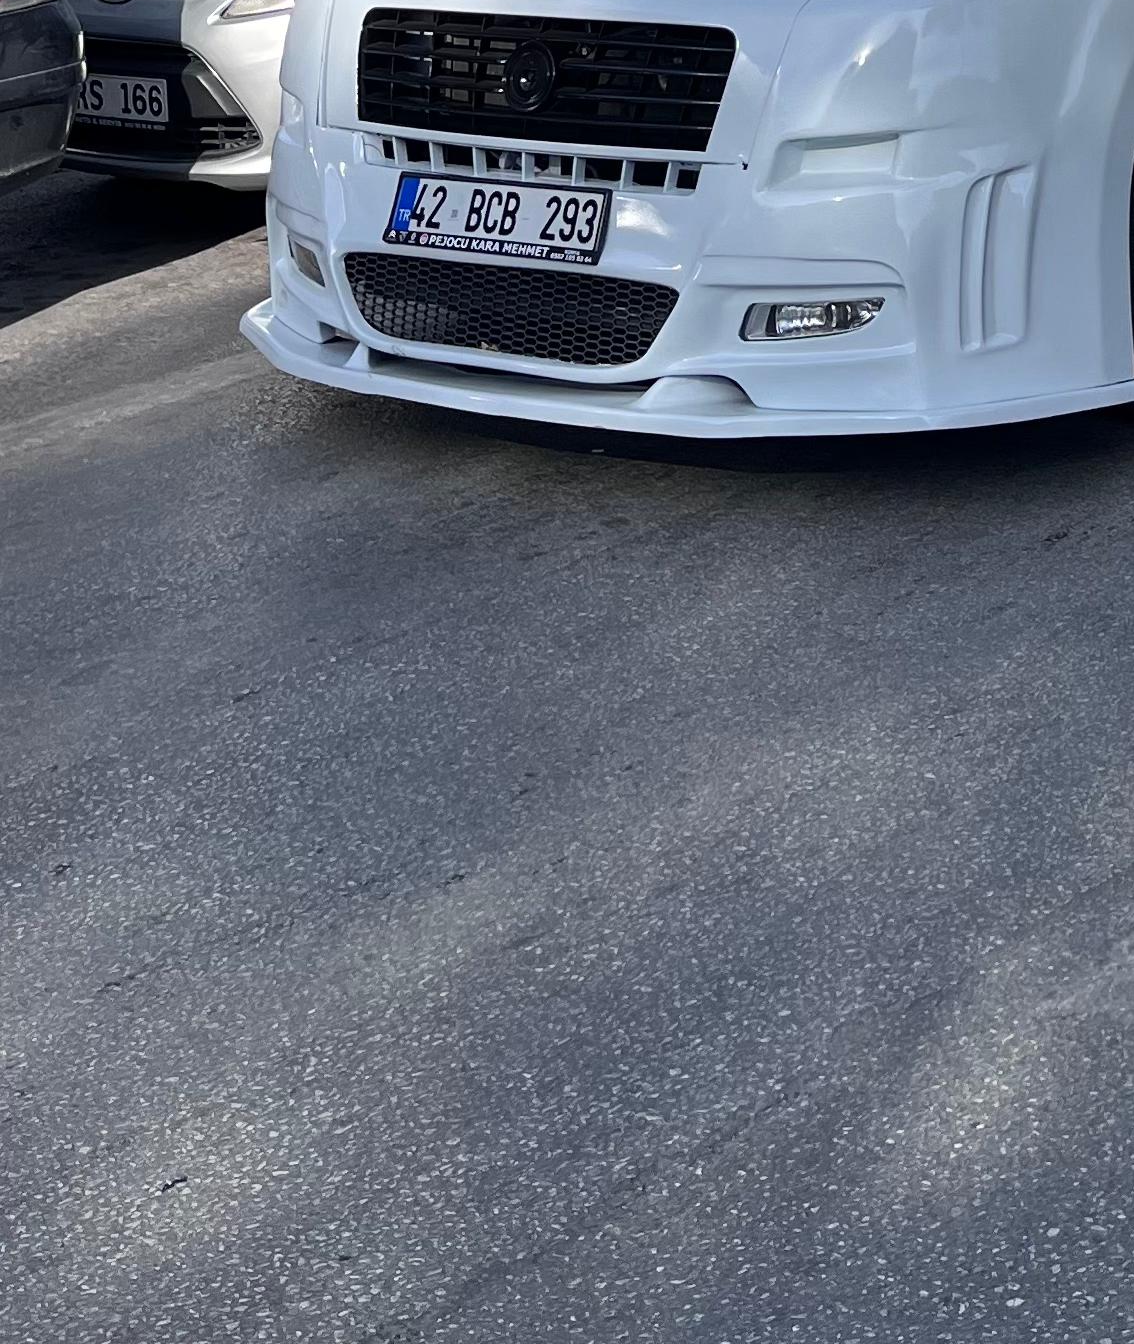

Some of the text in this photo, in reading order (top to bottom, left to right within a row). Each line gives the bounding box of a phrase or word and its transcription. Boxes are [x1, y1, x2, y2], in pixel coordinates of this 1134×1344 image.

[120, 82, 163, 117] 166
[398, 208, 410, 221] TR
[410, 183, 599, 244] 42 BCB 293
[428, 235, 549, 258] PEJOCU KARA MEHMET
